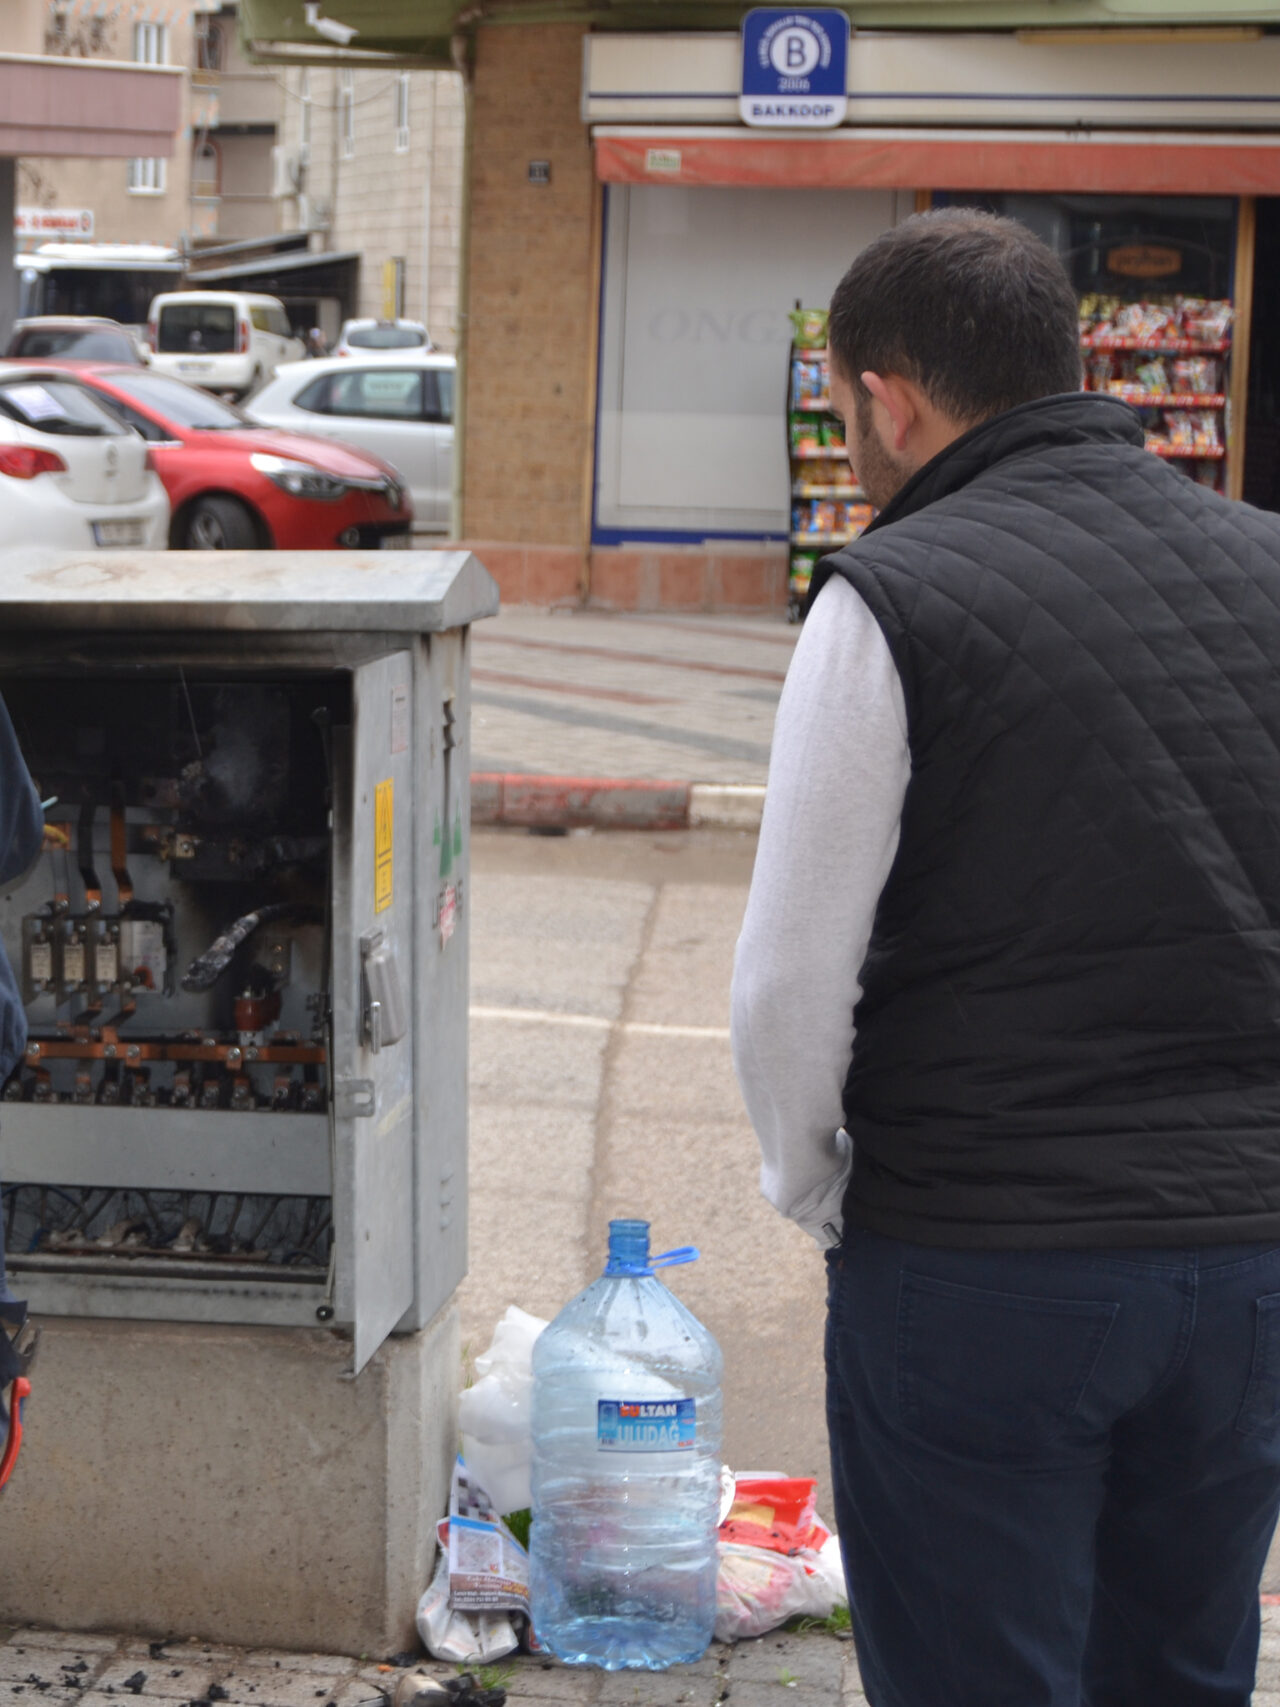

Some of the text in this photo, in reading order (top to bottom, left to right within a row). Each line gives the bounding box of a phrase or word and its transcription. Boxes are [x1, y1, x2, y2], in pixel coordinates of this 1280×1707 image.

[786, 35, 807, 68] B
[752, 104, 835, 117] BAKKOOP
[620, 1404, 677, 1417] SULTAN
[616, 1419, 680, 1447] ULUDAĞ
